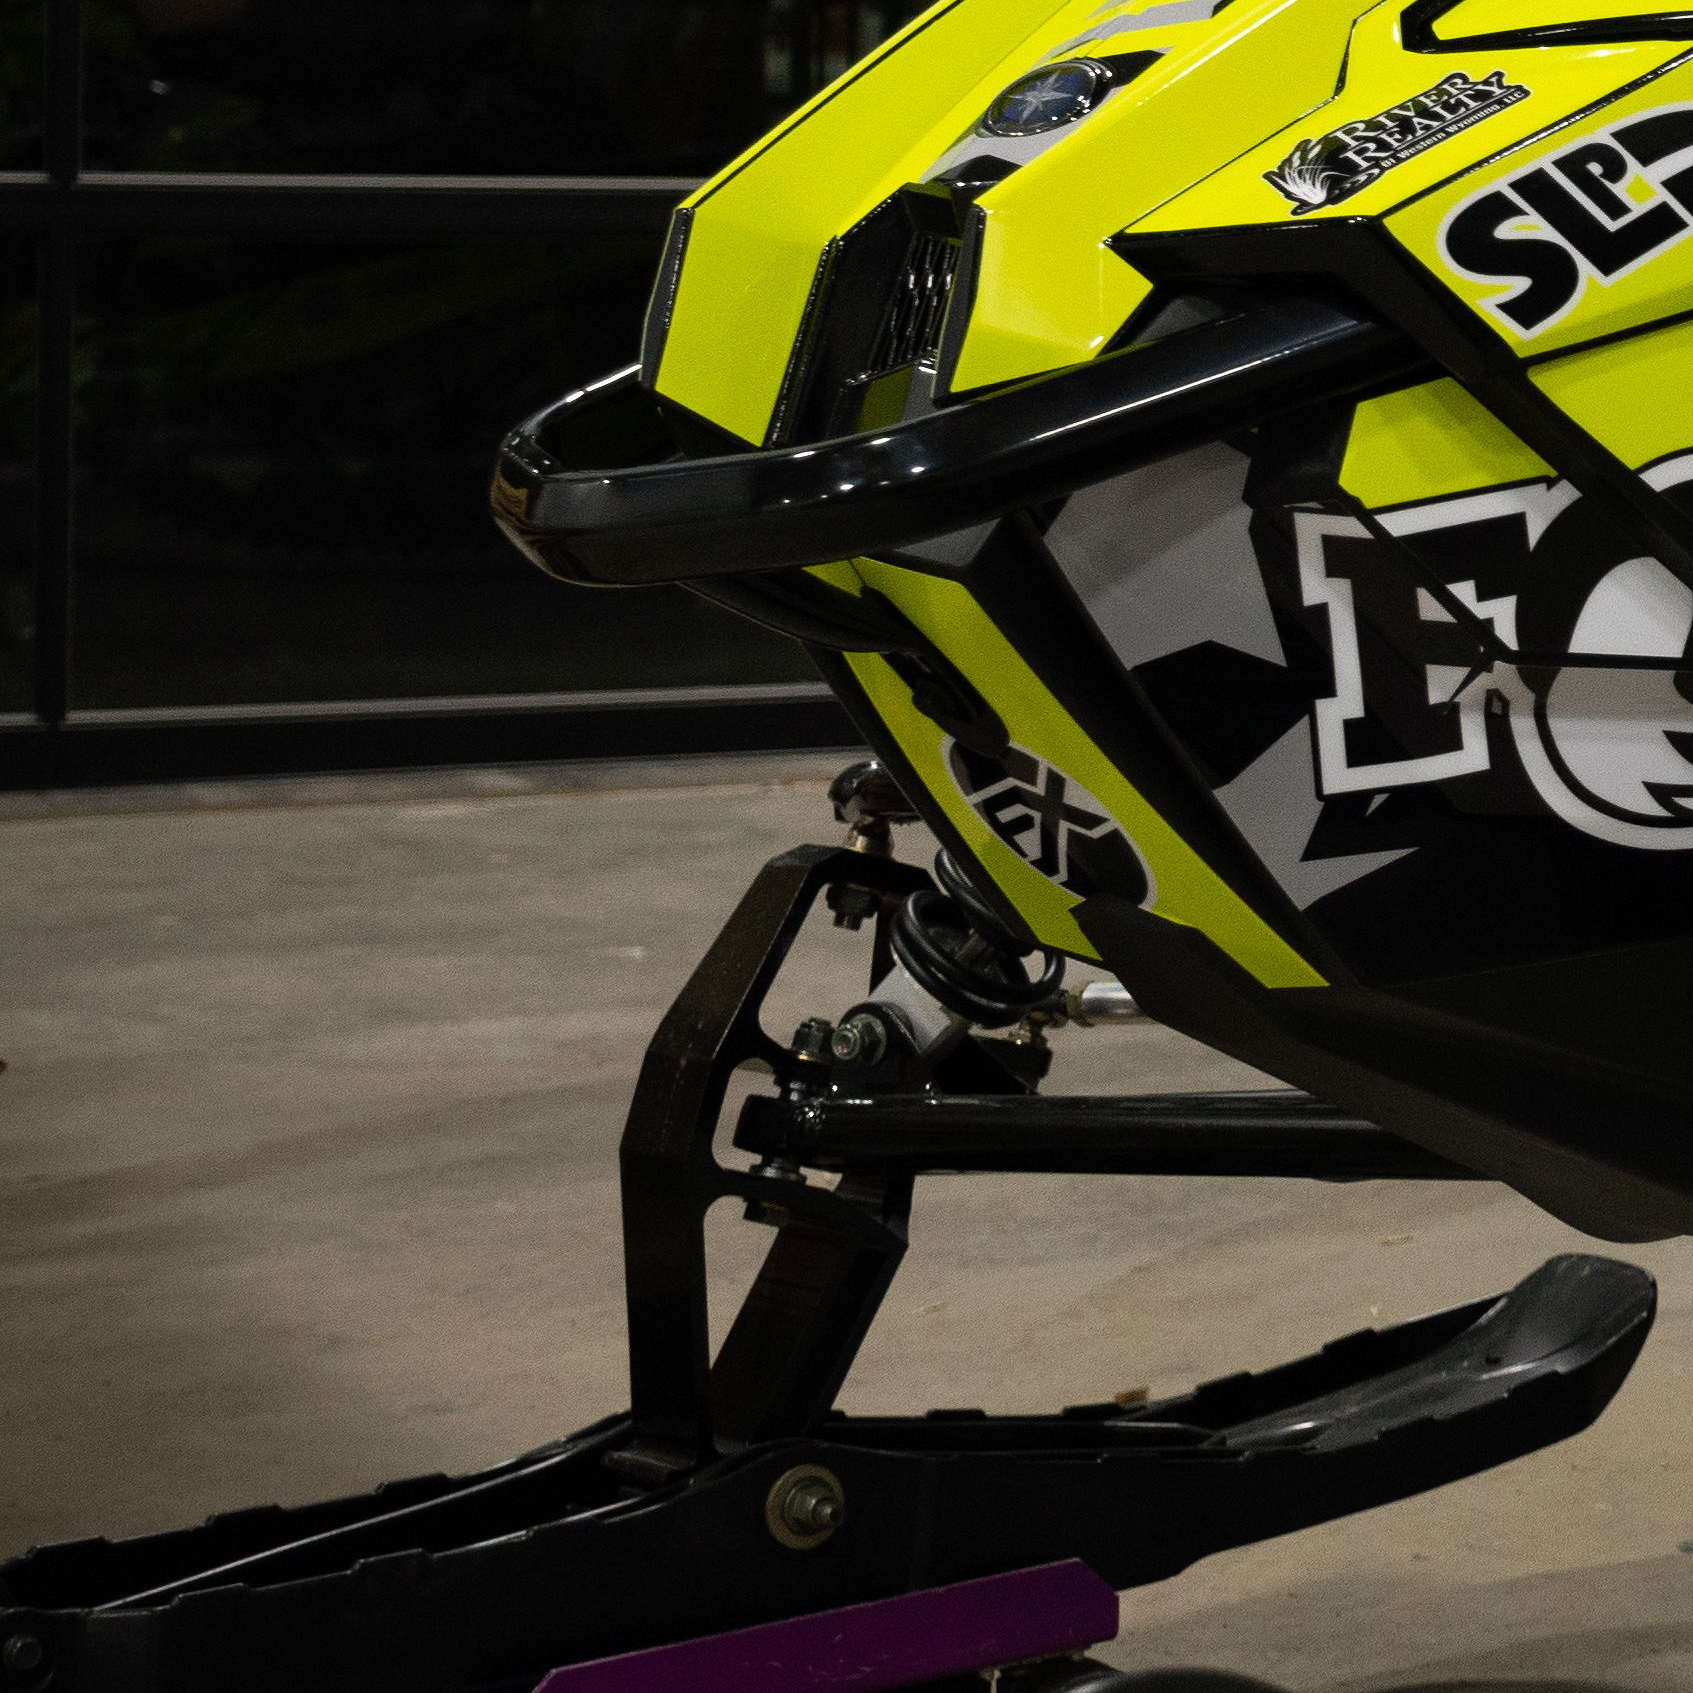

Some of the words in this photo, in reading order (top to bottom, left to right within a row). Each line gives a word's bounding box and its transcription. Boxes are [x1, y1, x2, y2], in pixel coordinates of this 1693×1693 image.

[1330, 76, 1474, 149] RIVER
[1340, 75, 1511, 171] REALTY
[1398, 130, 1447, 161] Western
[1446, 138, 1691, 332] SLP
